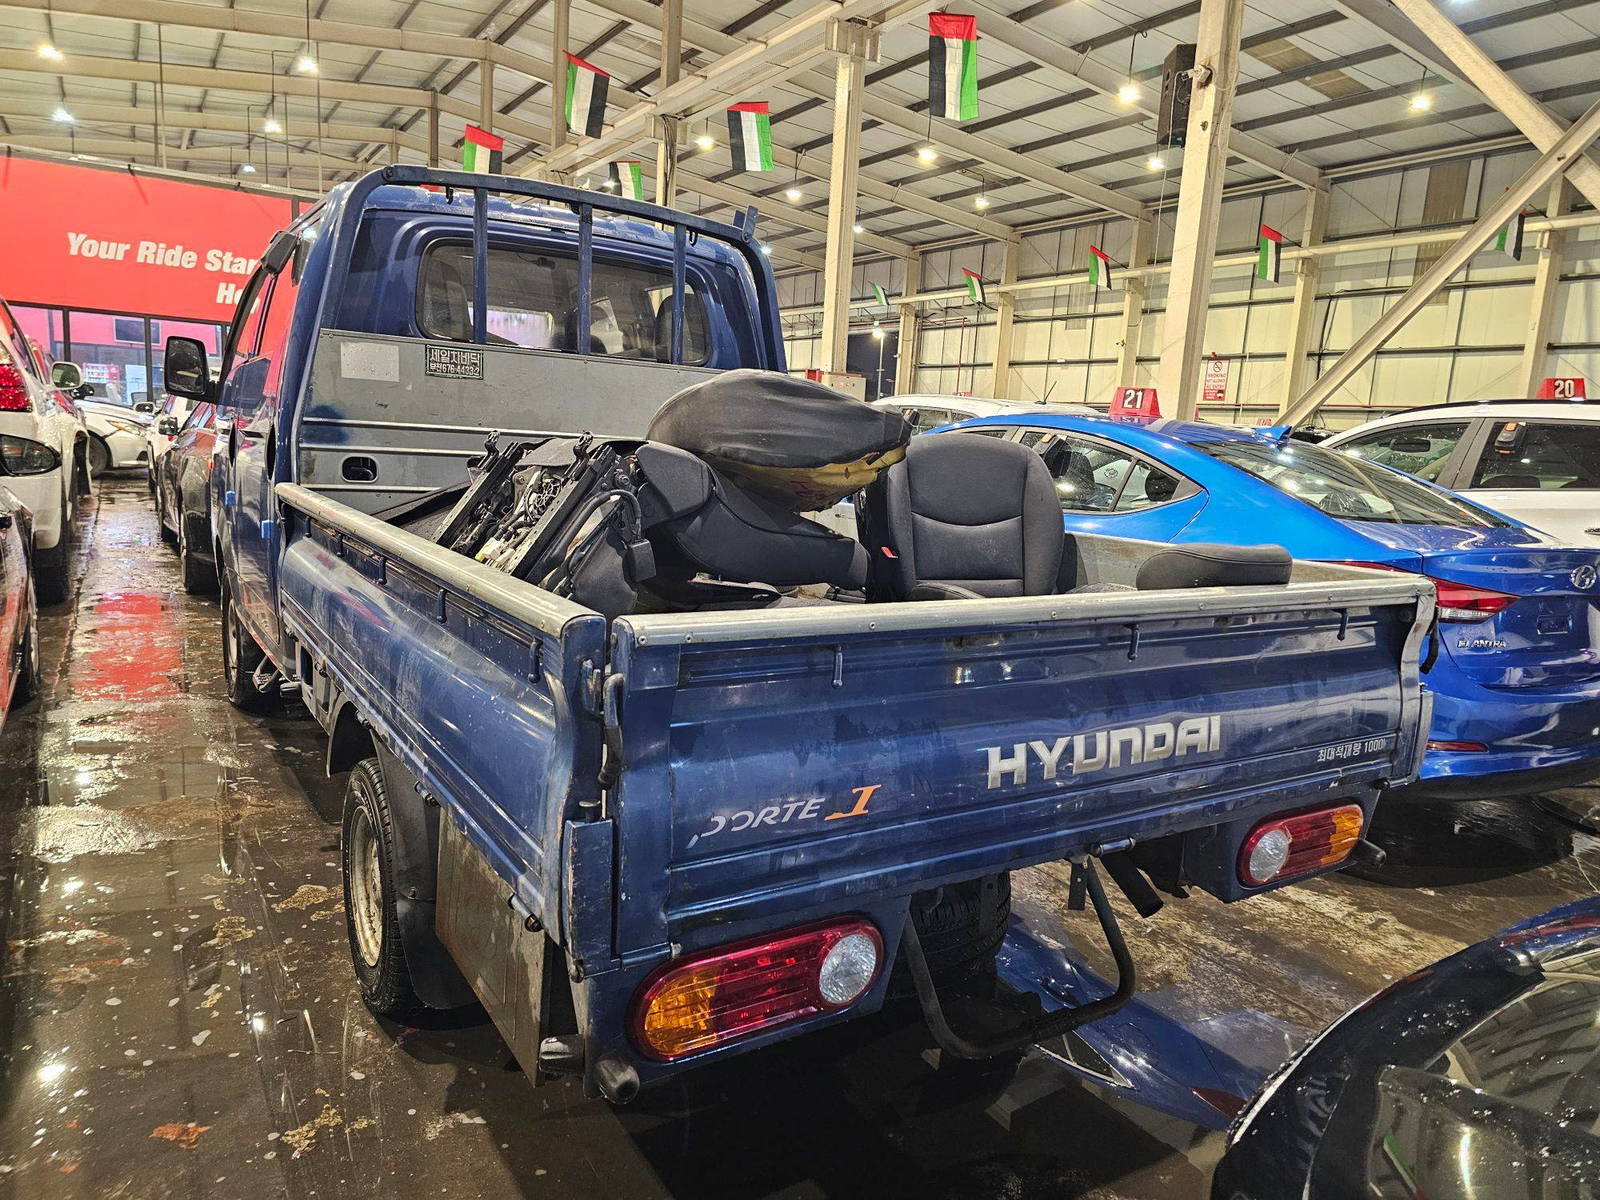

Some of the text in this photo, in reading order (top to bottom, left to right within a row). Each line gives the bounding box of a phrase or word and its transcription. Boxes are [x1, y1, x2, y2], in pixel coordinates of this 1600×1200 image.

[67, 232, 131, 261] Your
[136, 241, 198, 269] Ride
[1123, 389, 1143, 409] 21
[1554, 379, 1575, 398] 20
[987, 715, 1221, 789] HYUNDAI
